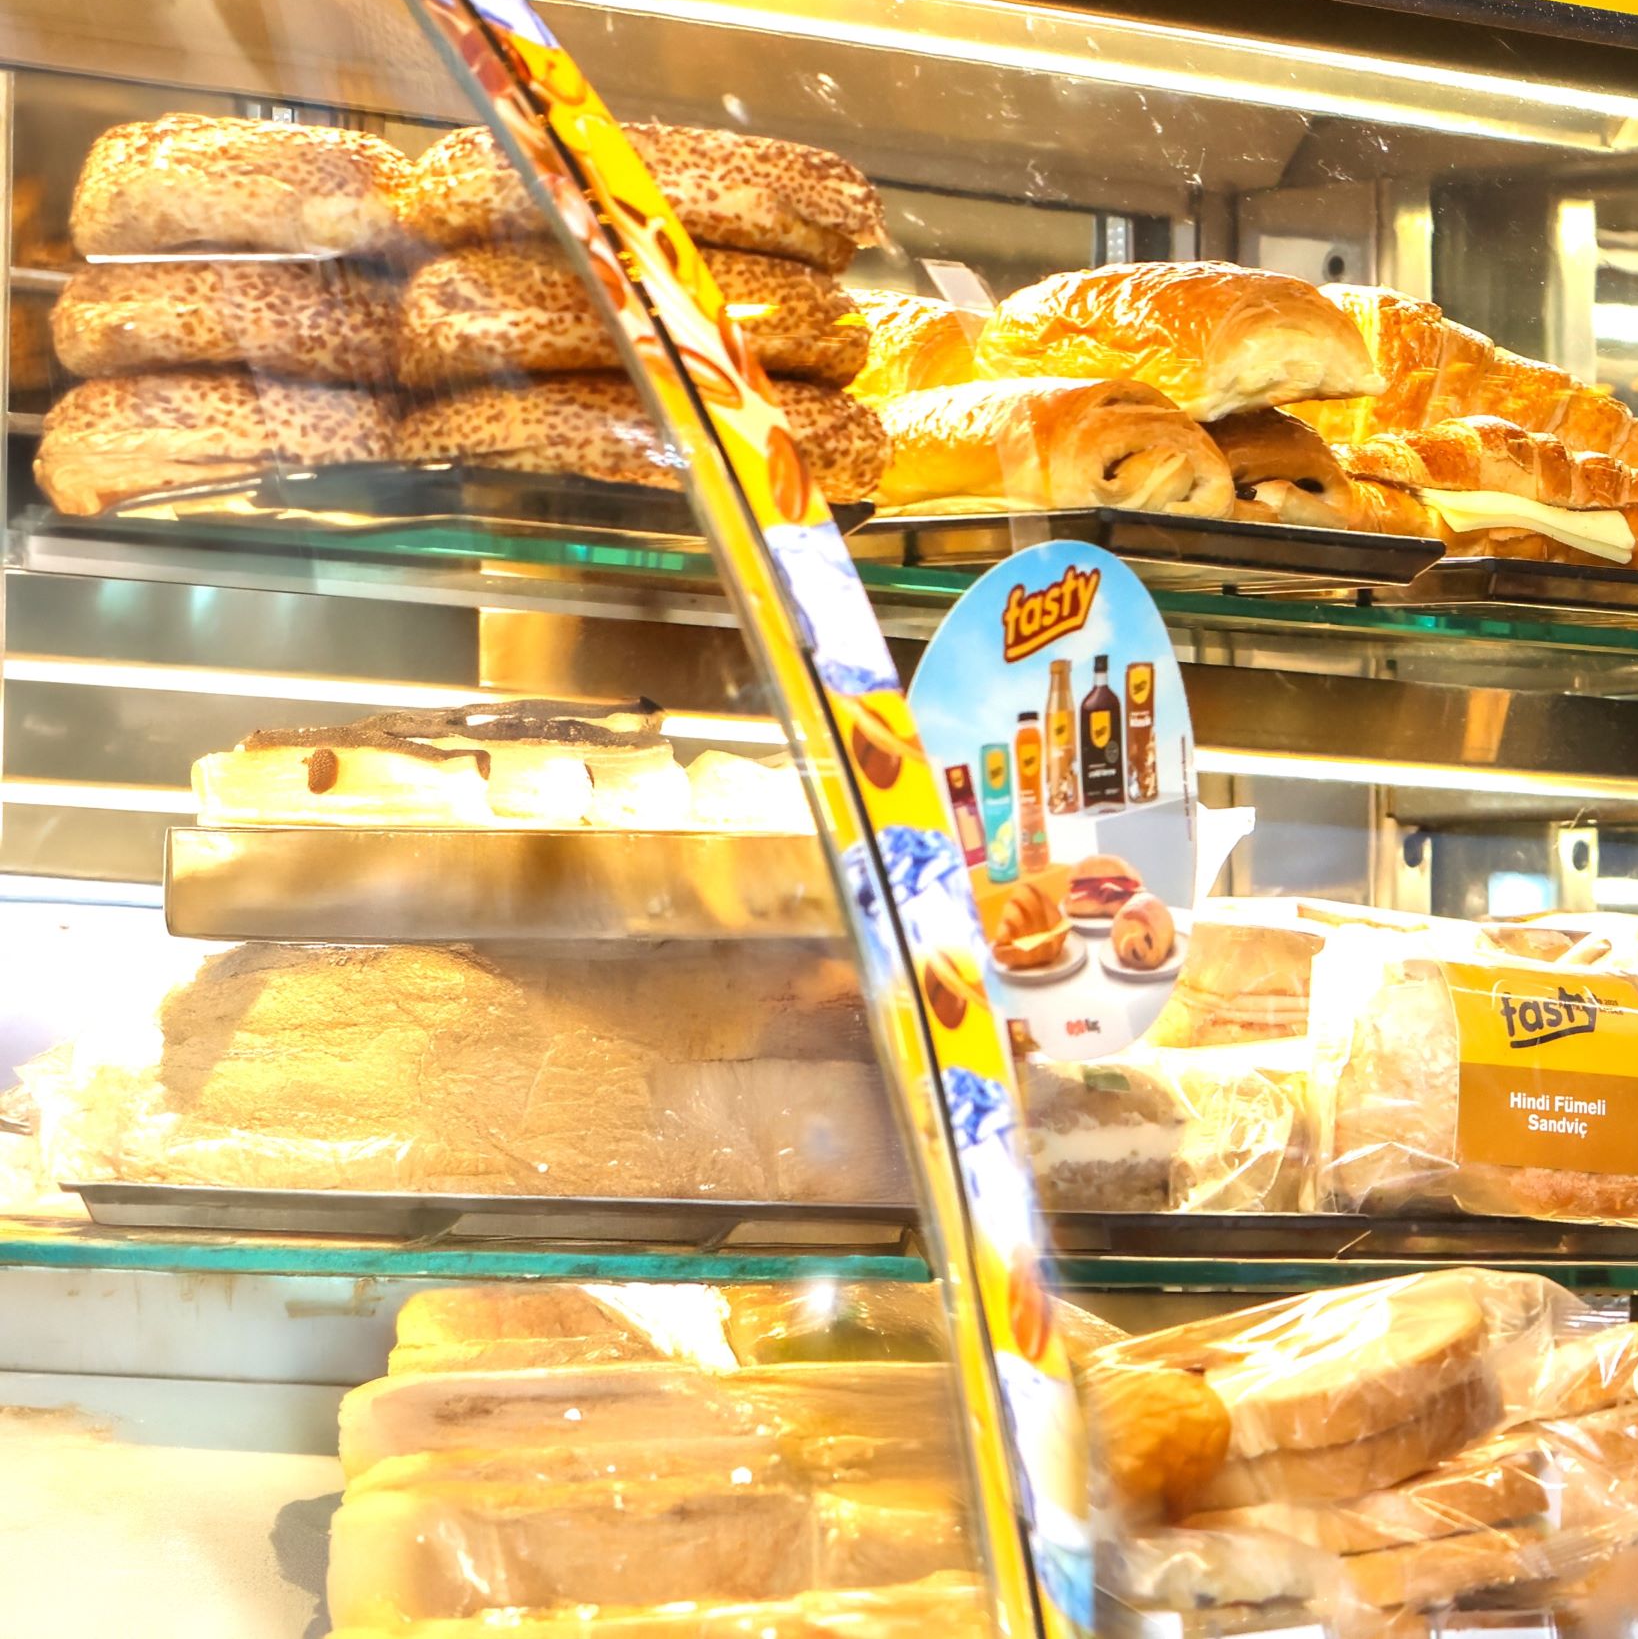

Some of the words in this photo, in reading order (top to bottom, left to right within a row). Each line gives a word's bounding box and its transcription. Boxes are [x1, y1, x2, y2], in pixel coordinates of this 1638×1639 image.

[1004, 570, 1099, 658] fasty
[1500, 985, 1598, 1049] fasty
[1509, 1091, 1550, 1112] Hindi
[1554, 1095, 1607, 1116] Fümeli
[1527, 1113, 1588, 1139] Sandviç
